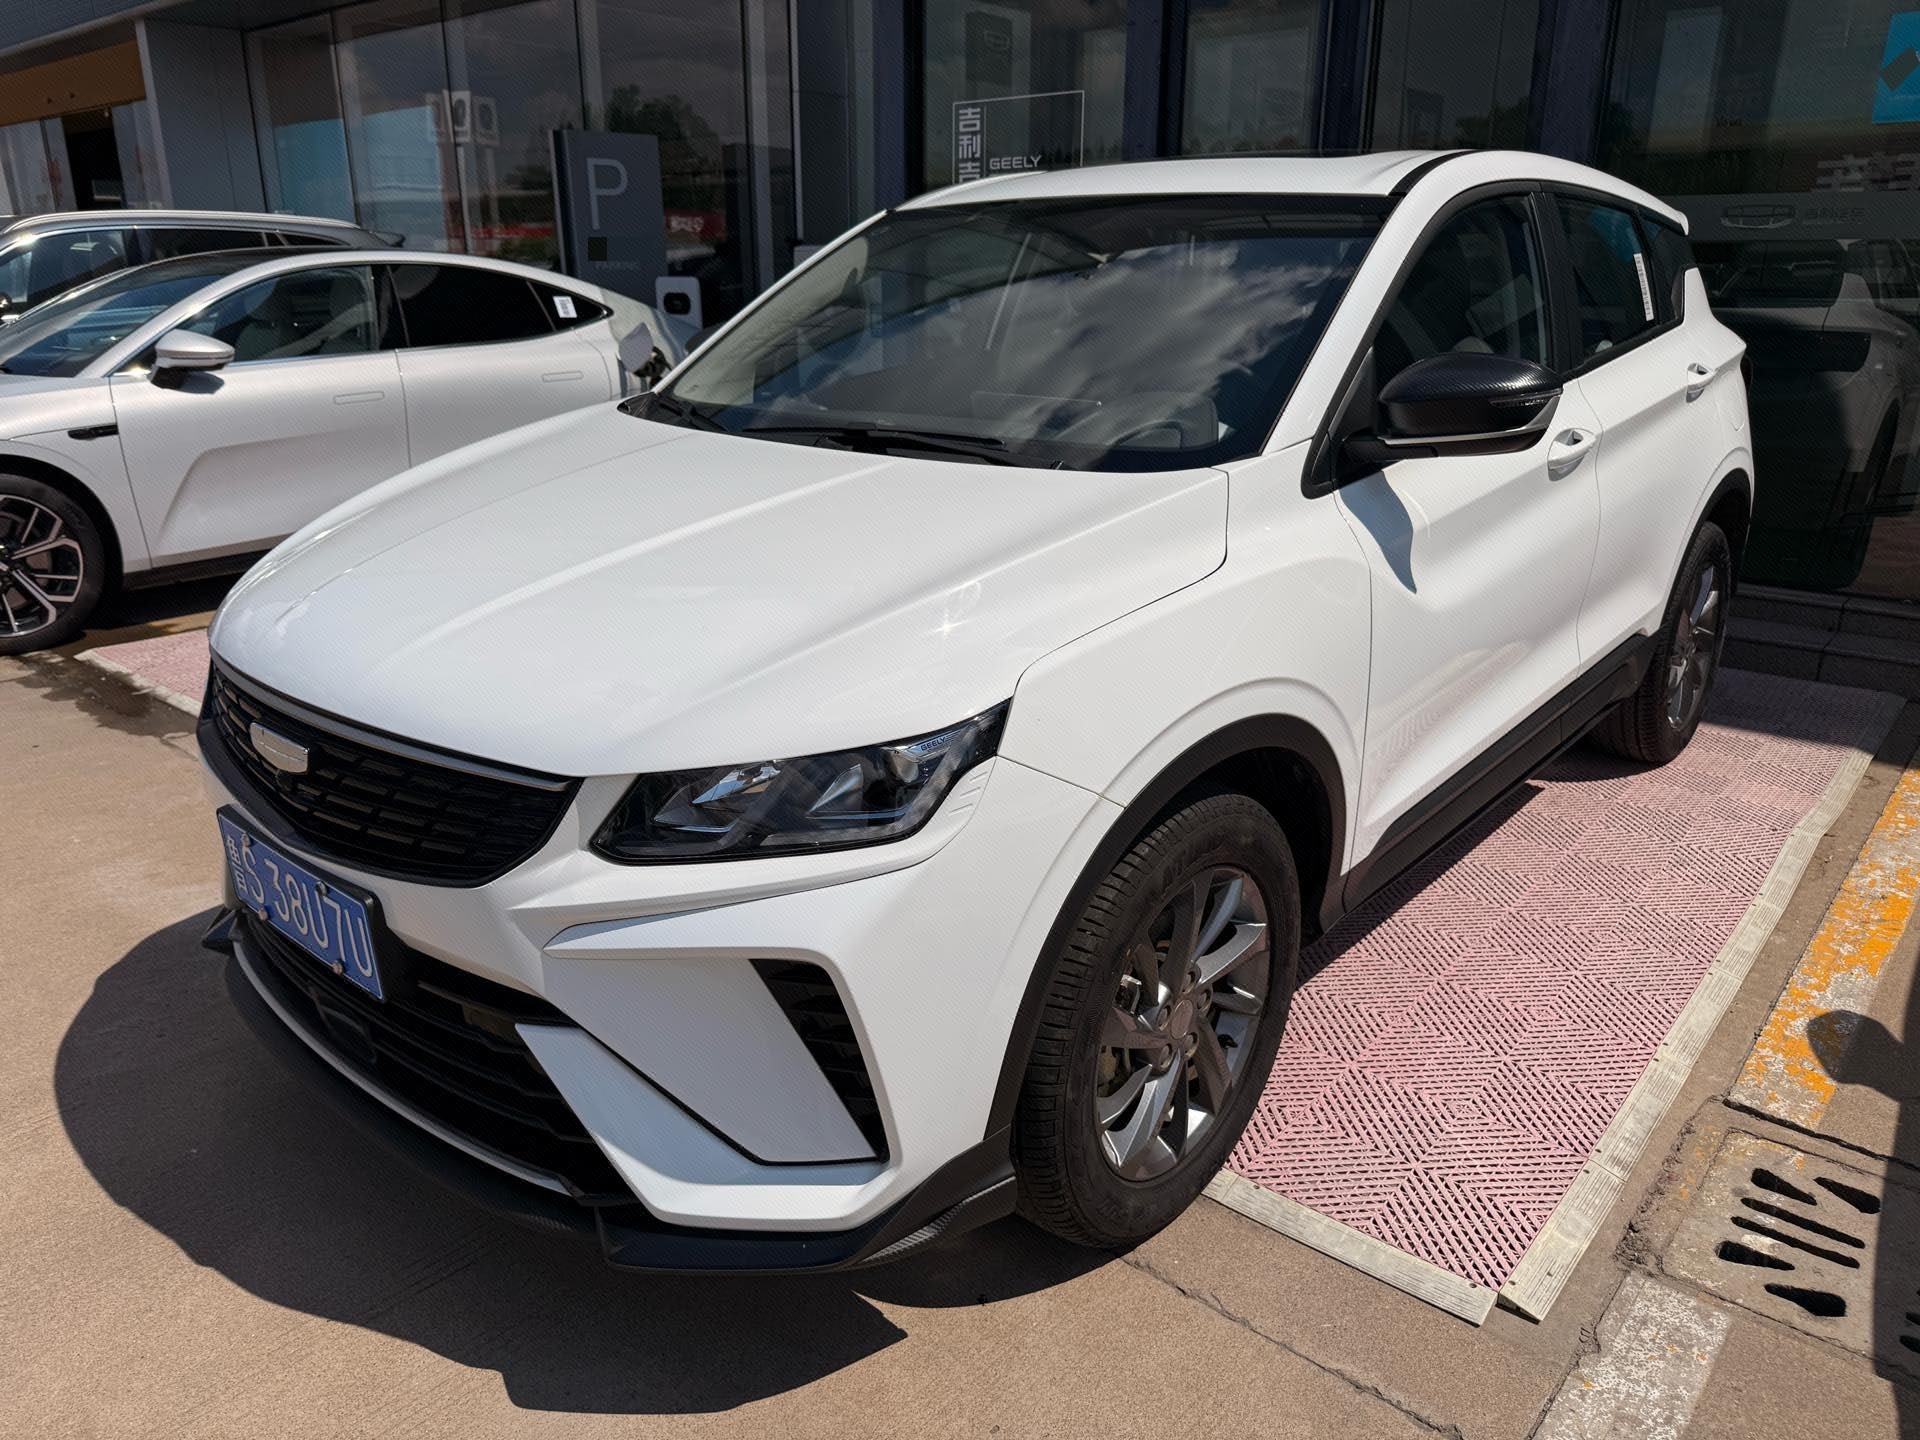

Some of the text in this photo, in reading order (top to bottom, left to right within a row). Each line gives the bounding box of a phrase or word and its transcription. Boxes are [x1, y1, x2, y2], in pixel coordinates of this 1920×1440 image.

[989, 155, 1041, 170] GEELY
[586, 157, 628, 230] P
[920, 736, 946, 751] GEELY
